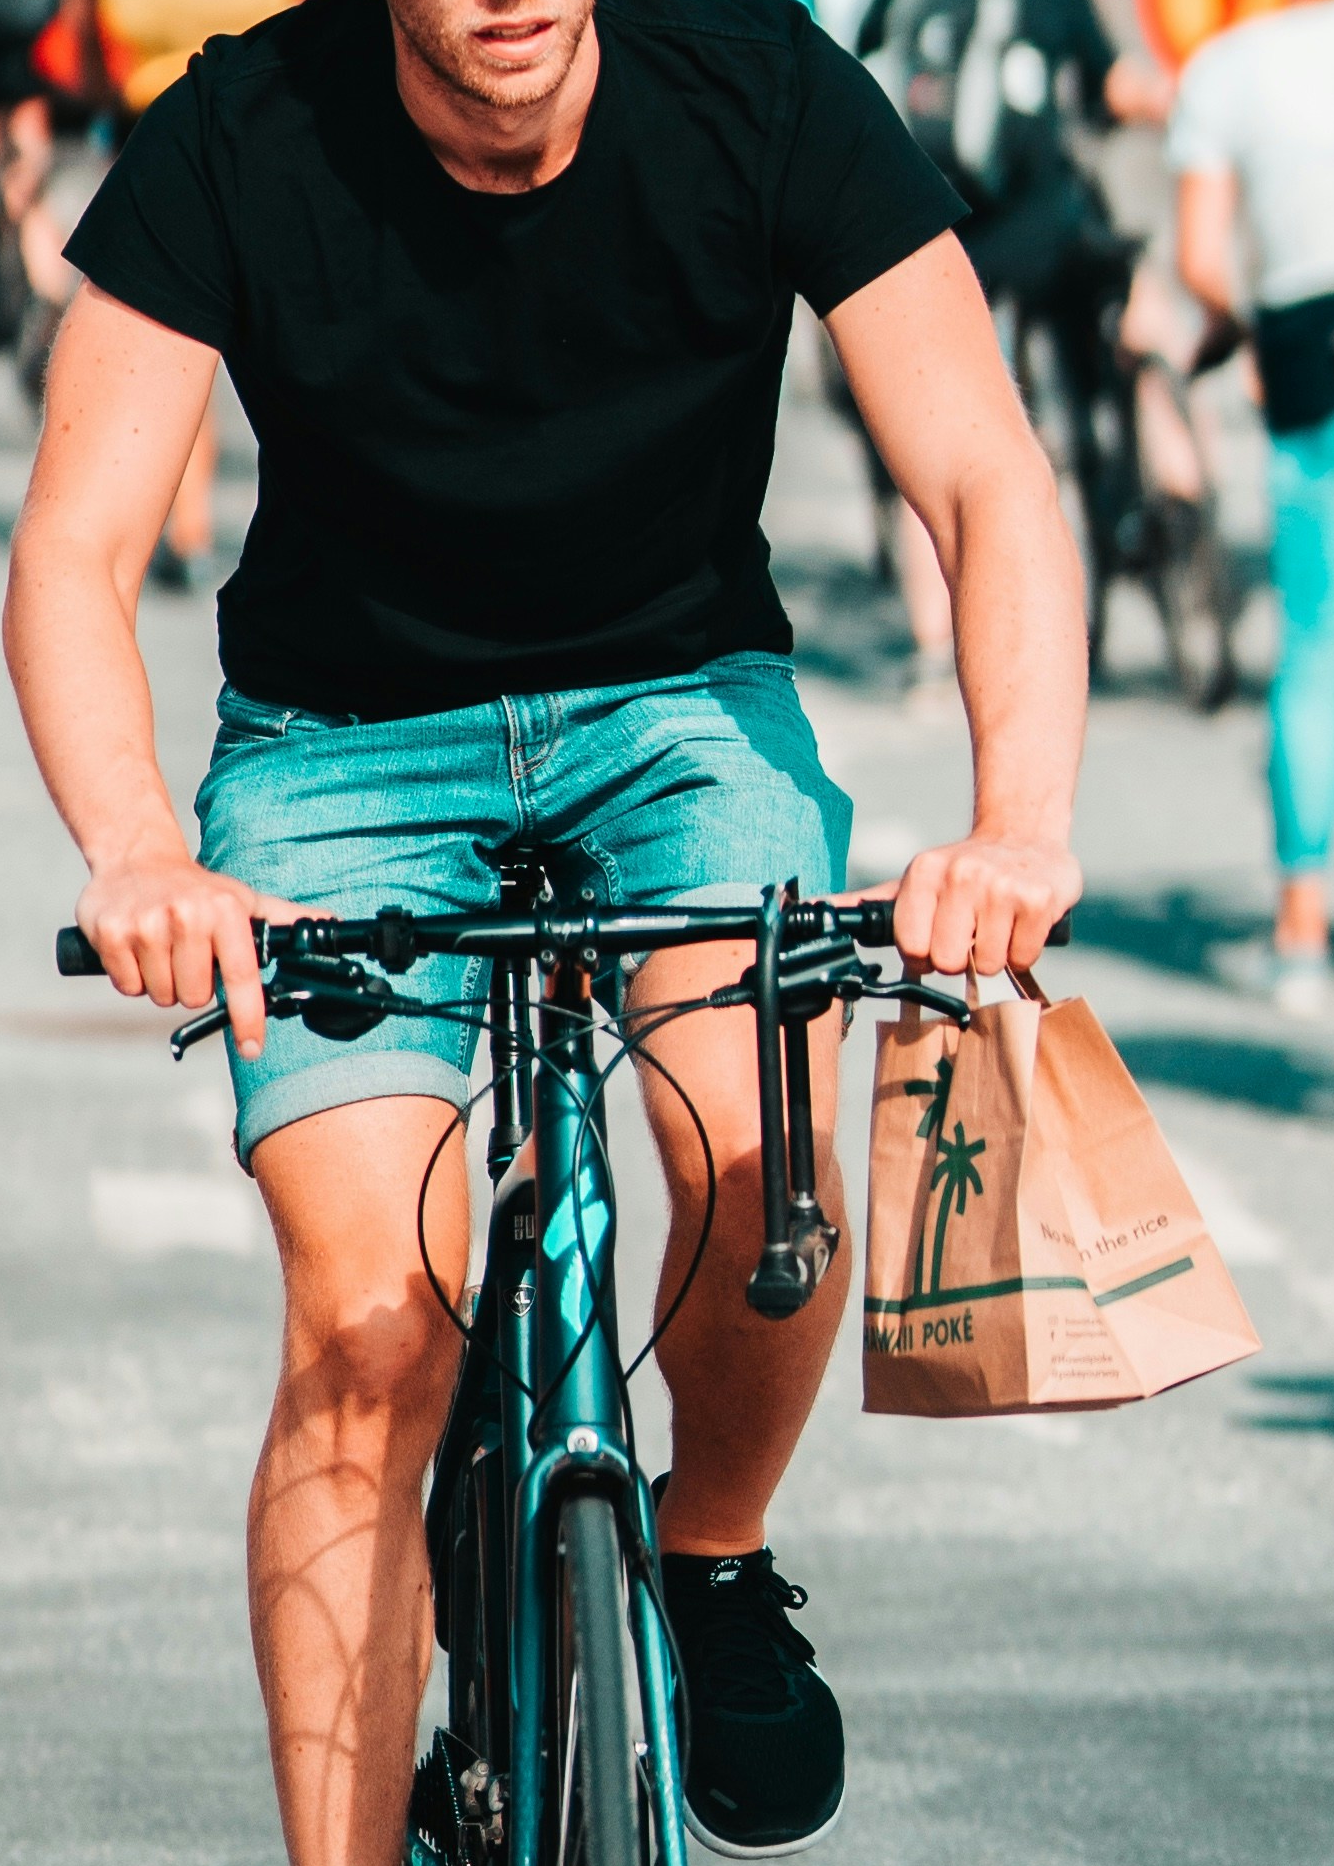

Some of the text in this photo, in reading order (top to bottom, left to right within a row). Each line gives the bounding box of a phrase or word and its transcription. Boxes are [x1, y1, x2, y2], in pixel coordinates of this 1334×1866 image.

[1095, 1234, 1129, 1255] the
[1133, 1213, 1169, 1241] rice
[923, 1307, 974, 1349] POKÉ
